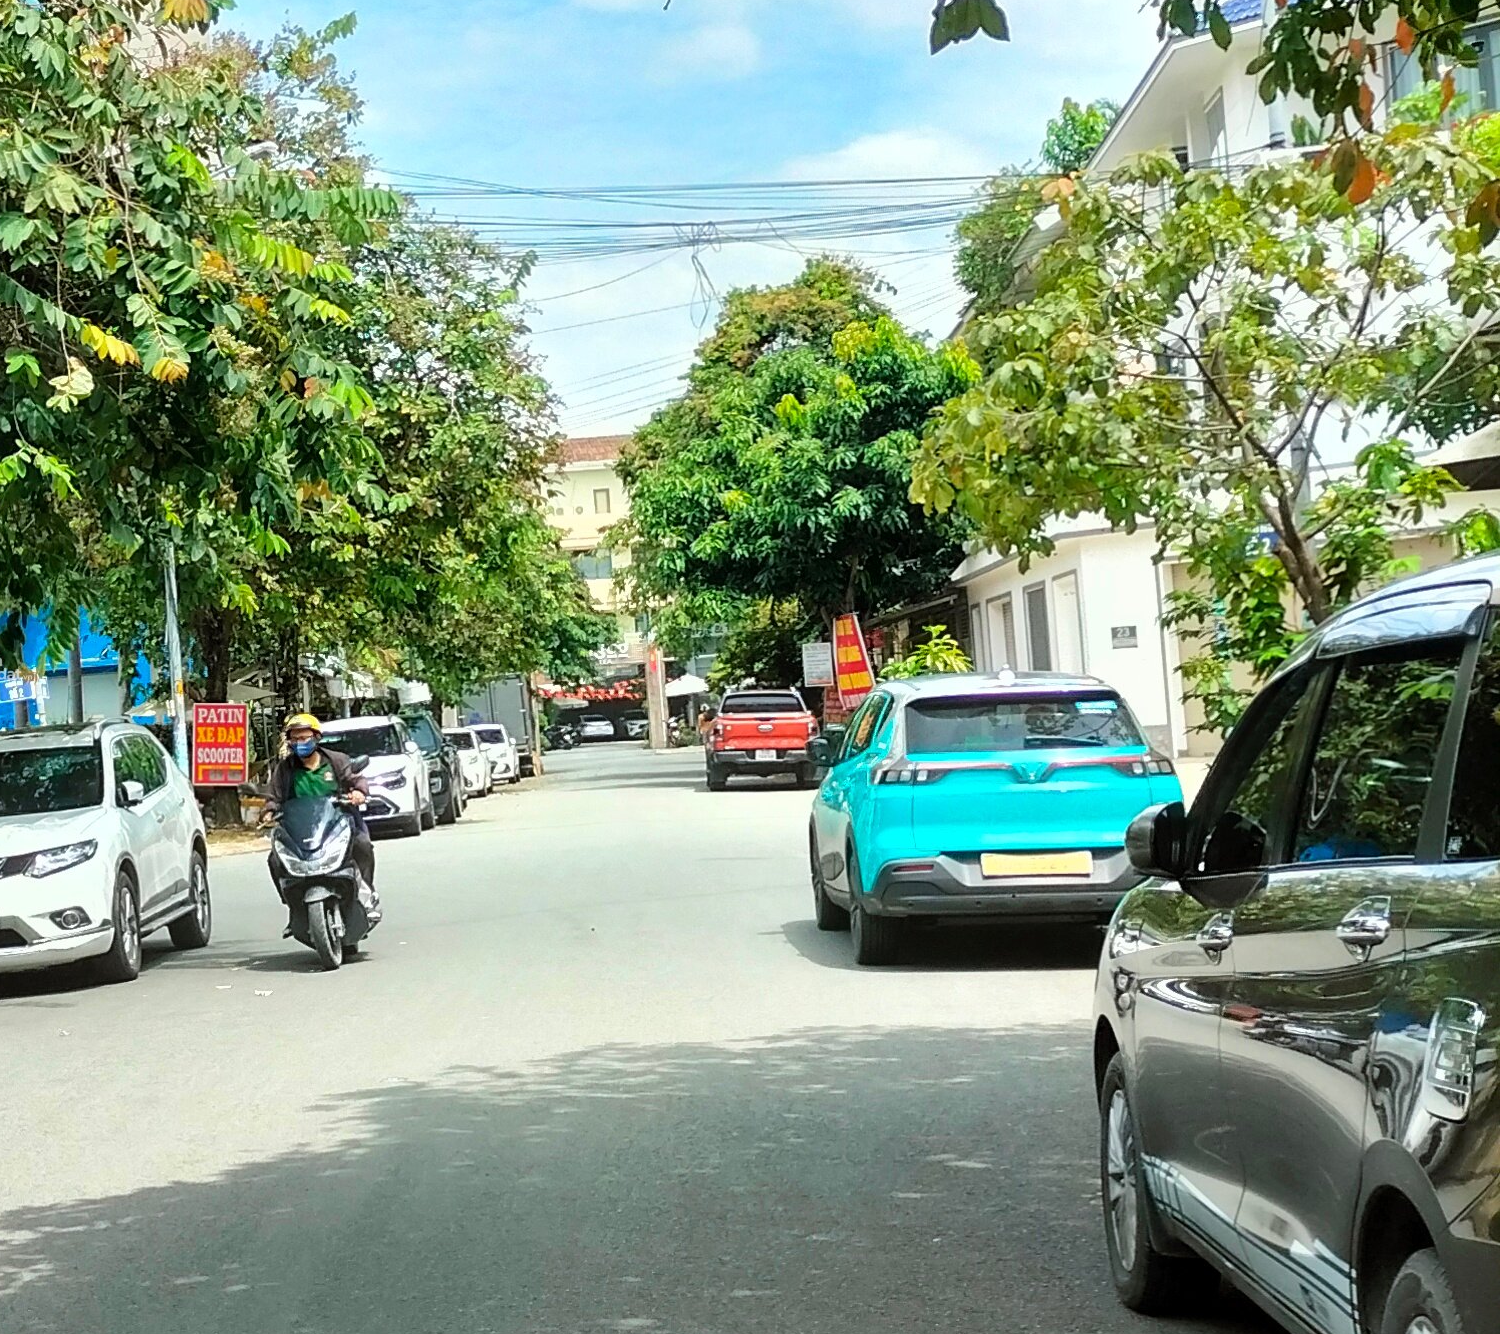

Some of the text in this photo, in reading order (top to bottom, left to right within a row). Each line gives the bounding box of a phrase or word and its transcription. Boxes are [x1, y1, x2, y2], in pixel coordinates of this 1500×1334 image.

[1116, 627, 1131, 638] 23
[198, 708, 244, 723] PATIN
[197, 727, 214, 742] XE
[198, 748, 244, 763] SCOOTER
